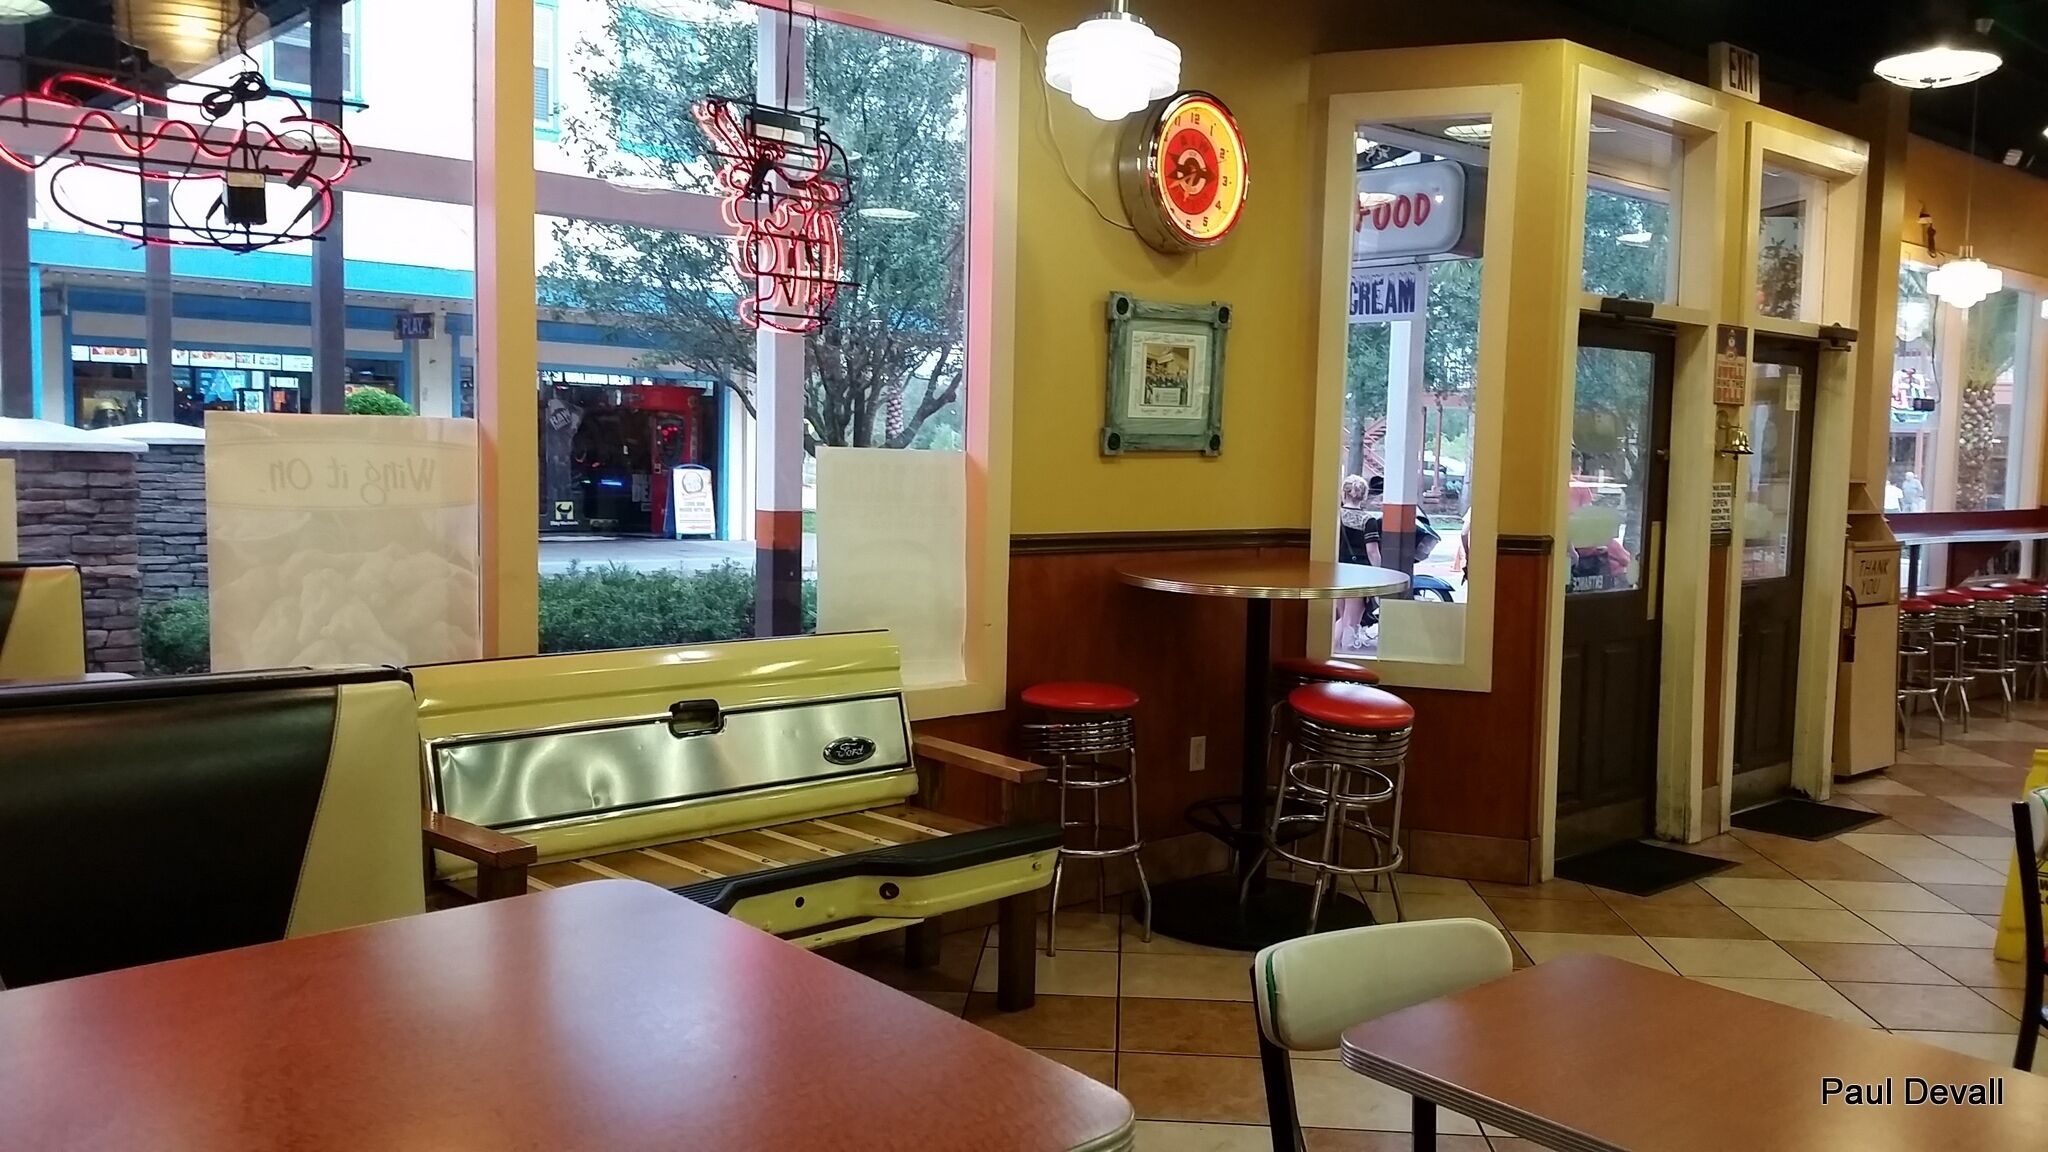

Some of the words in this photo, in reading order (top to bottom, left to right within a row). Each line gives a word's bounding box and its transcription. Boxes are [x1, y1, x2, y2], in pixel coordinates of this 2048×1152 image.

[1729, 47, 1754, 95] EXIT
[1349, 273, 1416, 316] CREAM
[1860, 559, 1890, 577] THANK
[1861, 578, 1880, 595] YOU
[836, 742, 864, 757] Ford
